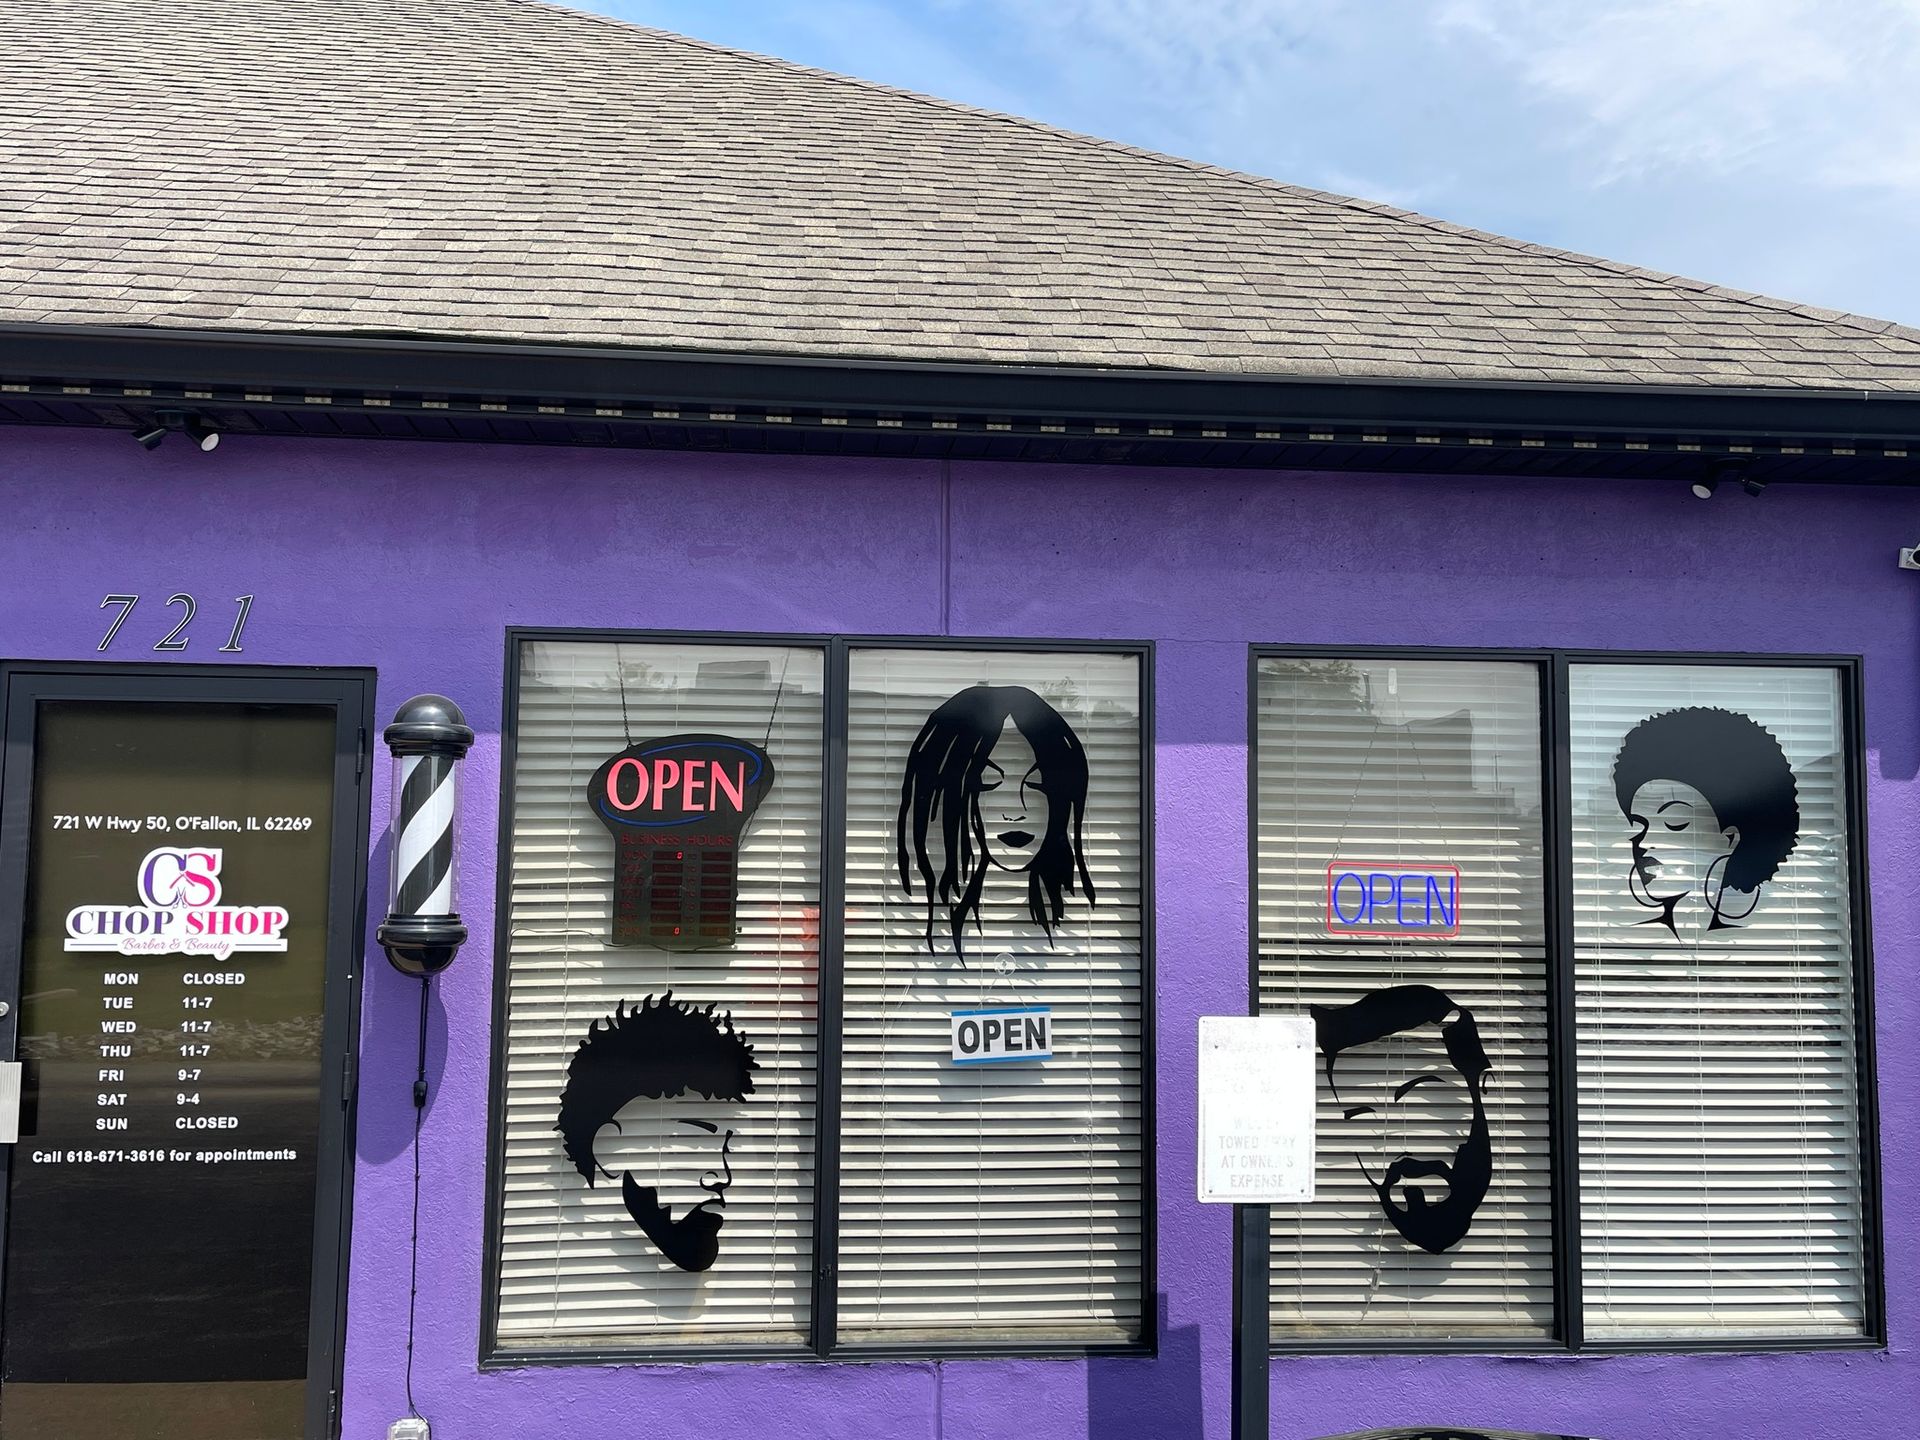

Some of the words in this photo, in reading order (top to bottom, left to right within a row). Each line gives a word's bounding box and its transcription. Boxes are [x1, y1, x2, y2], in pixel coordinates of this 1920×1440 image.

[606, 757, 745, 812] OPEN
[53, 815, 80, 831] 721
[85, 815, 103, 830] W
[107, 815, 143, 834] Hwy
[146, 815, 171, 833] 50,
[175, 815, 242, 833] O'Fallon,
[246, 816, 261, 831] IL
[264, 816, 313, 832] 62269
[622, 833, 680, 846] BUSINESS
[687, 834, 734, 847] HOURS
[143, 852, 216, 908] CS
[1333, 872, 1456, 927] OPEN
[72, 910, 174, 935] CHOP
[186, 911, 283, 936] SHOP
[121, 938, 167, 951] Barber
[168, 938, 180, 950] &
[185, 938, 231, 954] Beauty
[103, 972, 139, 986] MON
[182, 972, 246, 986] CLOSED
[102, 996, 134, 1009] TUE
[182, 996, 213, 1009] 11-7
[101, 1021, 137, 1034] WED
[181, 1020, 212, 1033] 11-7
[958, 1017, 1047, 1054] OPEN
[100, 1045, 132, 1058] THU
[179, 1044, 211, 1057] 11-7
[98, 1069, 124, 1082] FRI
[177, 1068, 201, 1081] 9-7
[97, 1093, 127, 1106] SAT
[176, 1092, 200, 1106] 9-4
[95, 1117, 128, 1131] SUN
[175, 1116, 239, 1130] CLOSED
[1219, 1135, 1259, 1149] TOWED
[32, 1150, 62, 1163] Call
[66, 1149, 165, 1163] 618-671-3616
[169, 1149, 192, 1162] for
[195, 1148, 297, 1164] appointments
[1221, 1155, 1236, 1169] AT
[1230, 1174, 1284, 1188] EXPENSE
